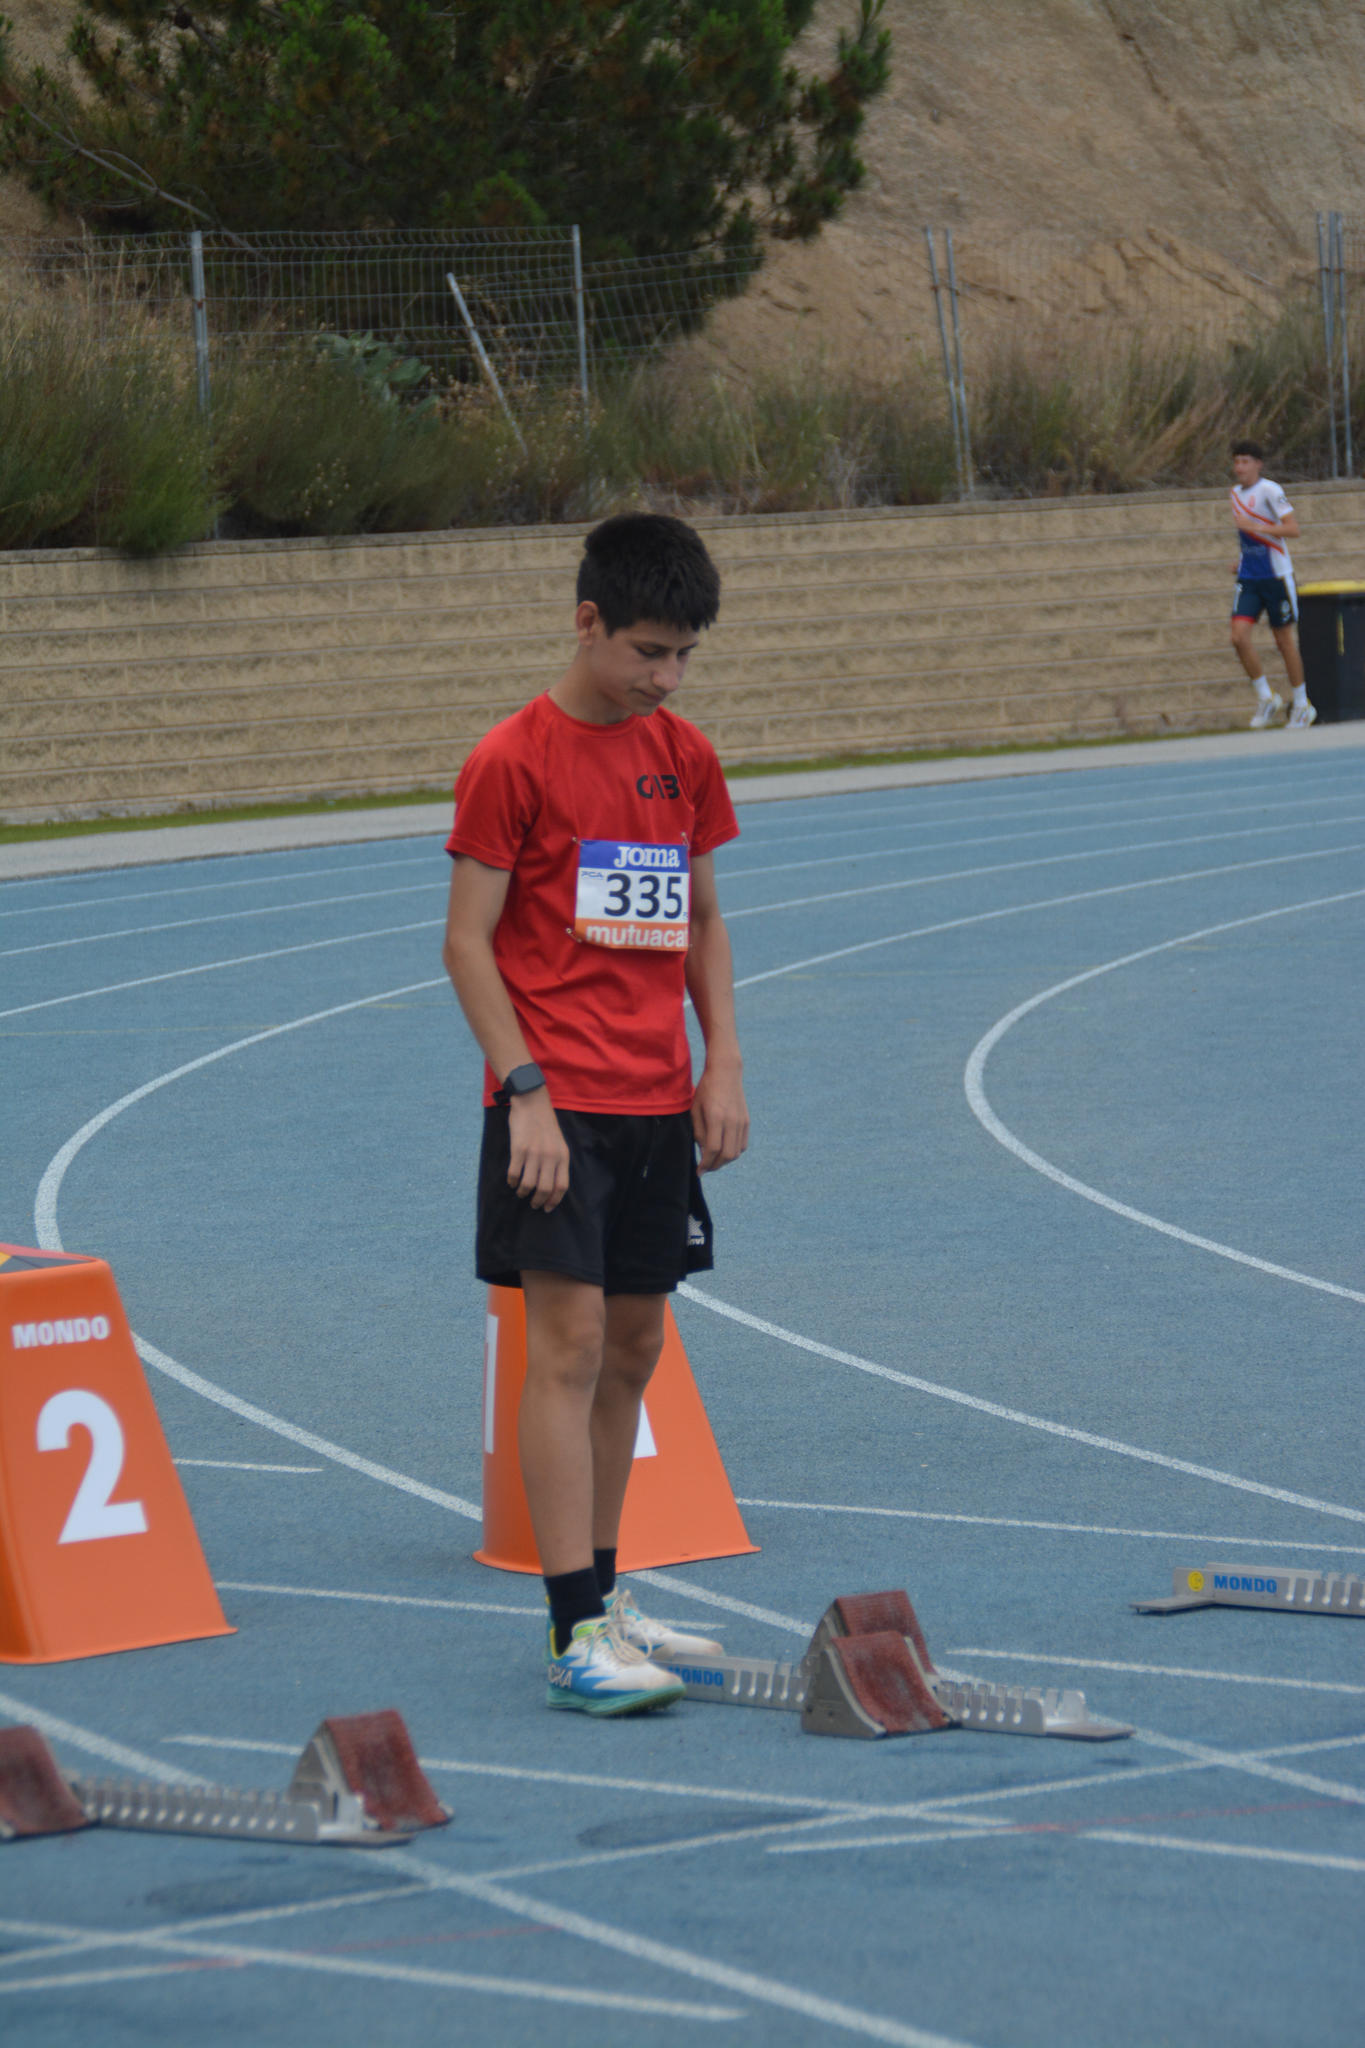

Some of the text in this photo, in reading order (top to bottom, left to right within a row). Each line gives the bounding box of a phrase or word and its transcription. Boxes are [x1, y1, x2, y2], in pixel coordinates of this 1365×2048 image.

[604, 872, 683, 919] 335
[11, 1315, 109, 1349] MONDO
[36, 1389, 148, 1545] 2
[1213, 1575, 1277, 1593] MONDO
[547, 1663, 573, 1689] OKA
